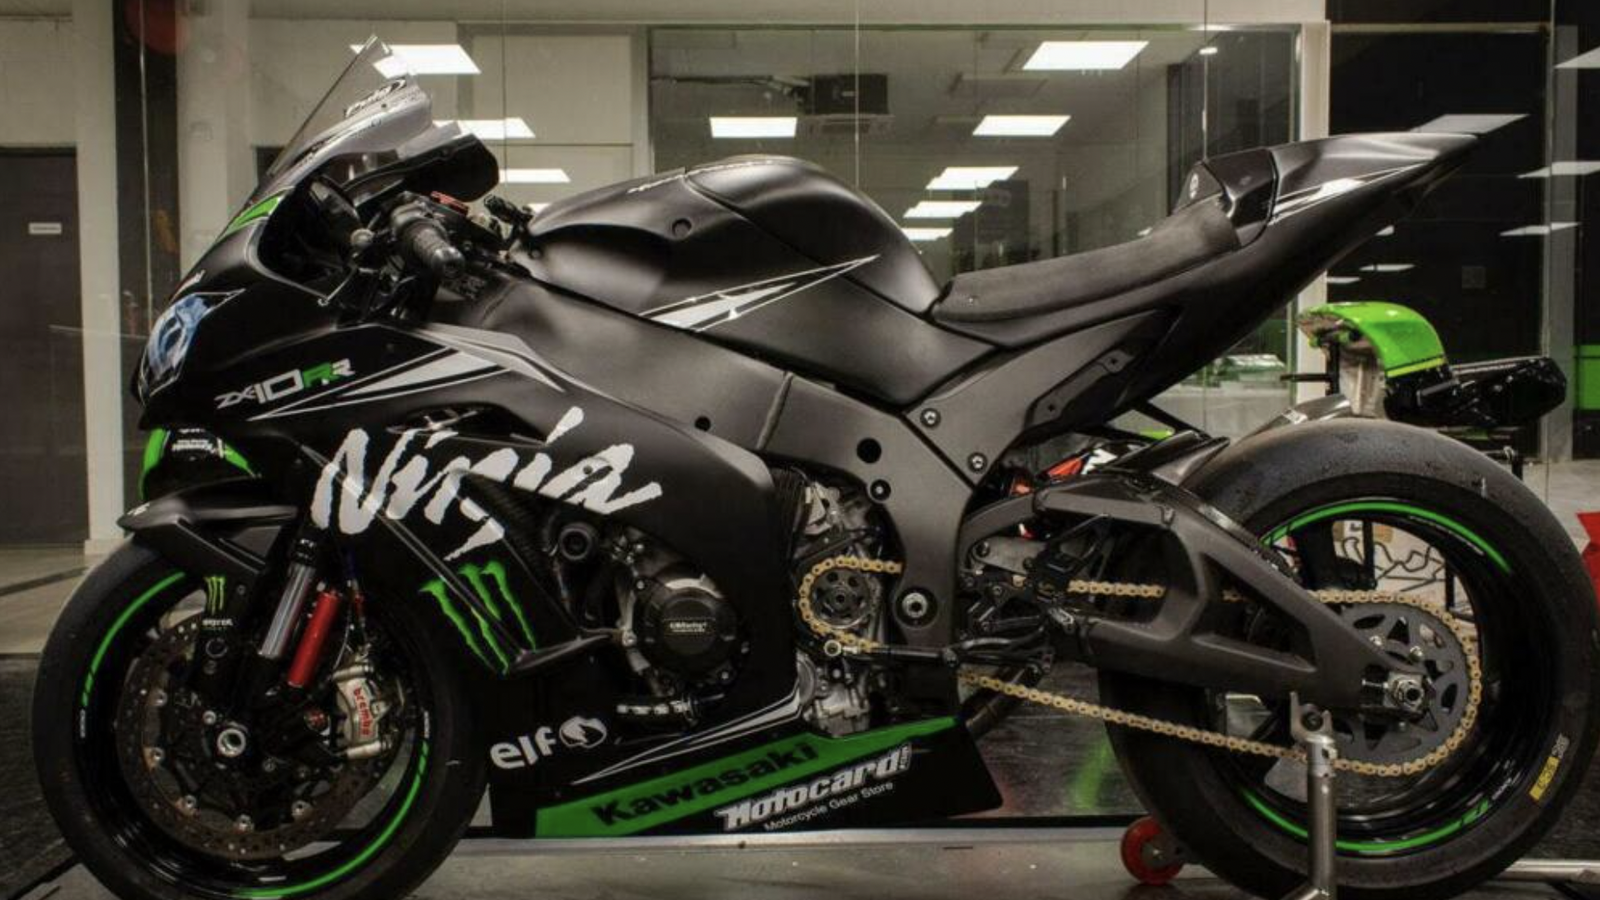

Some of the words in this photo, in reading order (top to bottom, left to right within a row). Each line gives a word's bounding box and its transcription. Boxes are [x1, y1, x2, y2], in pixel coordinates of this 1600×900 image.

[310, 405, 663, 561] Ninja
[353, 687, 375, 736] brembo
[489, 725, 557, 770] elf
[591, 741, 819, 827] Kawasaki
[828, 794, 860, 813] Gear
[860, 781, 895, 801] Store
